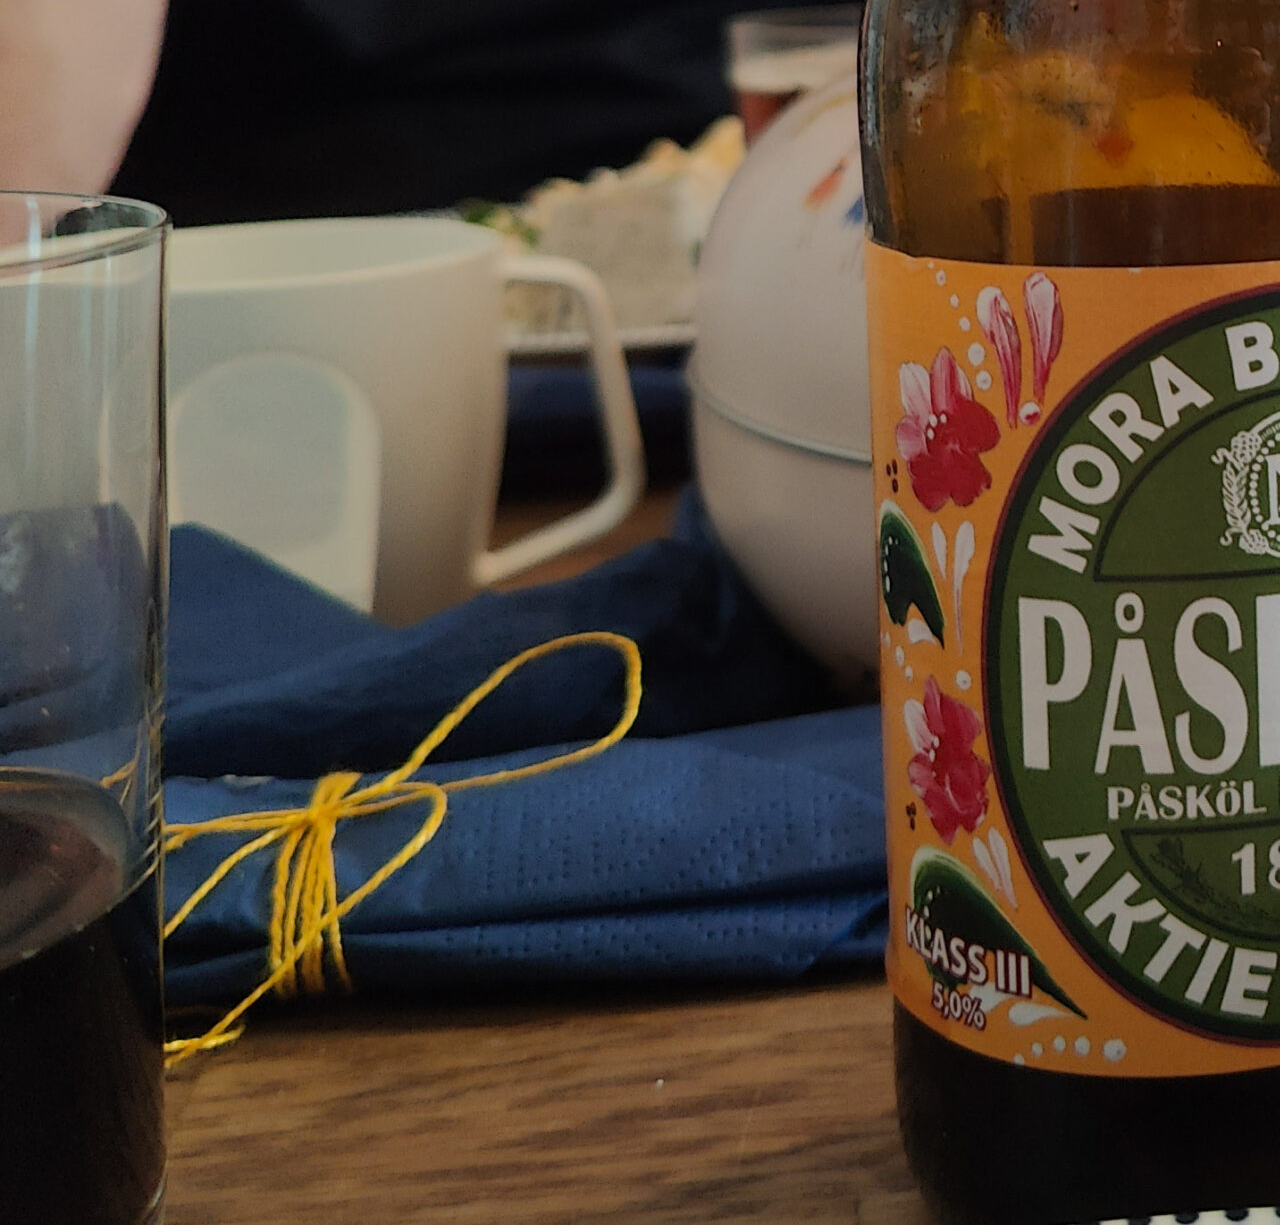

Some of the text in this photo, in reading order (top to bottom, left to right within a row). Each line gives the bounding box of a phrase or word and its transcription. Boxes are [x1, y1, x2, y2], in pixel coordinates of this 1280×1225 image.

[1027, 355, 1215, 575] MORA
[1107, 780, 1267, 822] PÅSKÖL
[906, 906, 1031, 997] KLASS III
[933, 981, 986, 1030] 5,0%
